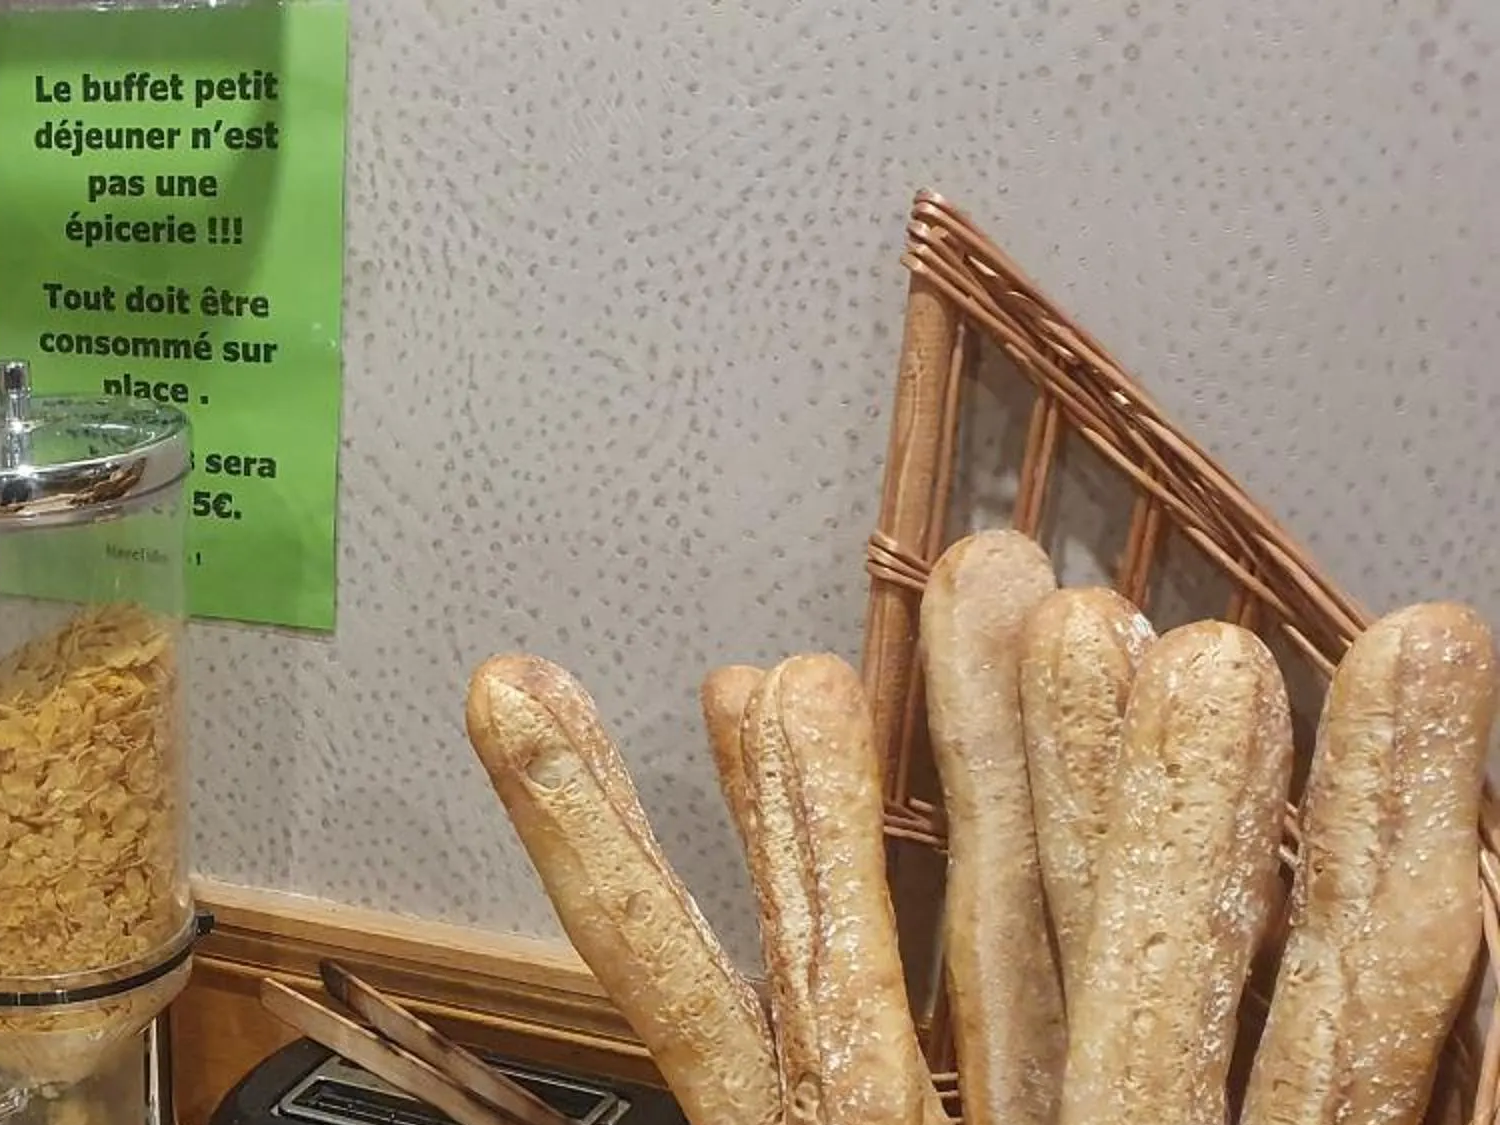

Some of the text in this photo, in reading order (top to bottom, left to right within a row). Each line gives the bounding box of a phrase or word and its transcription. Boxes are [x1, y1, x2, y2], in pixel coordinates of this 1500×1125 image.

[35, 69, 279, 109] Le buffet petit
[34, 119, 181, 157] déjeuner
[87, 174, 218, 204] pas une
[65, 211, 243, 249] épicerie !!!
[42, 282, 269, 318] Tout doit être
[39, 330, 278, 364] consommé sur
[204, 453, 277, 479] sera
